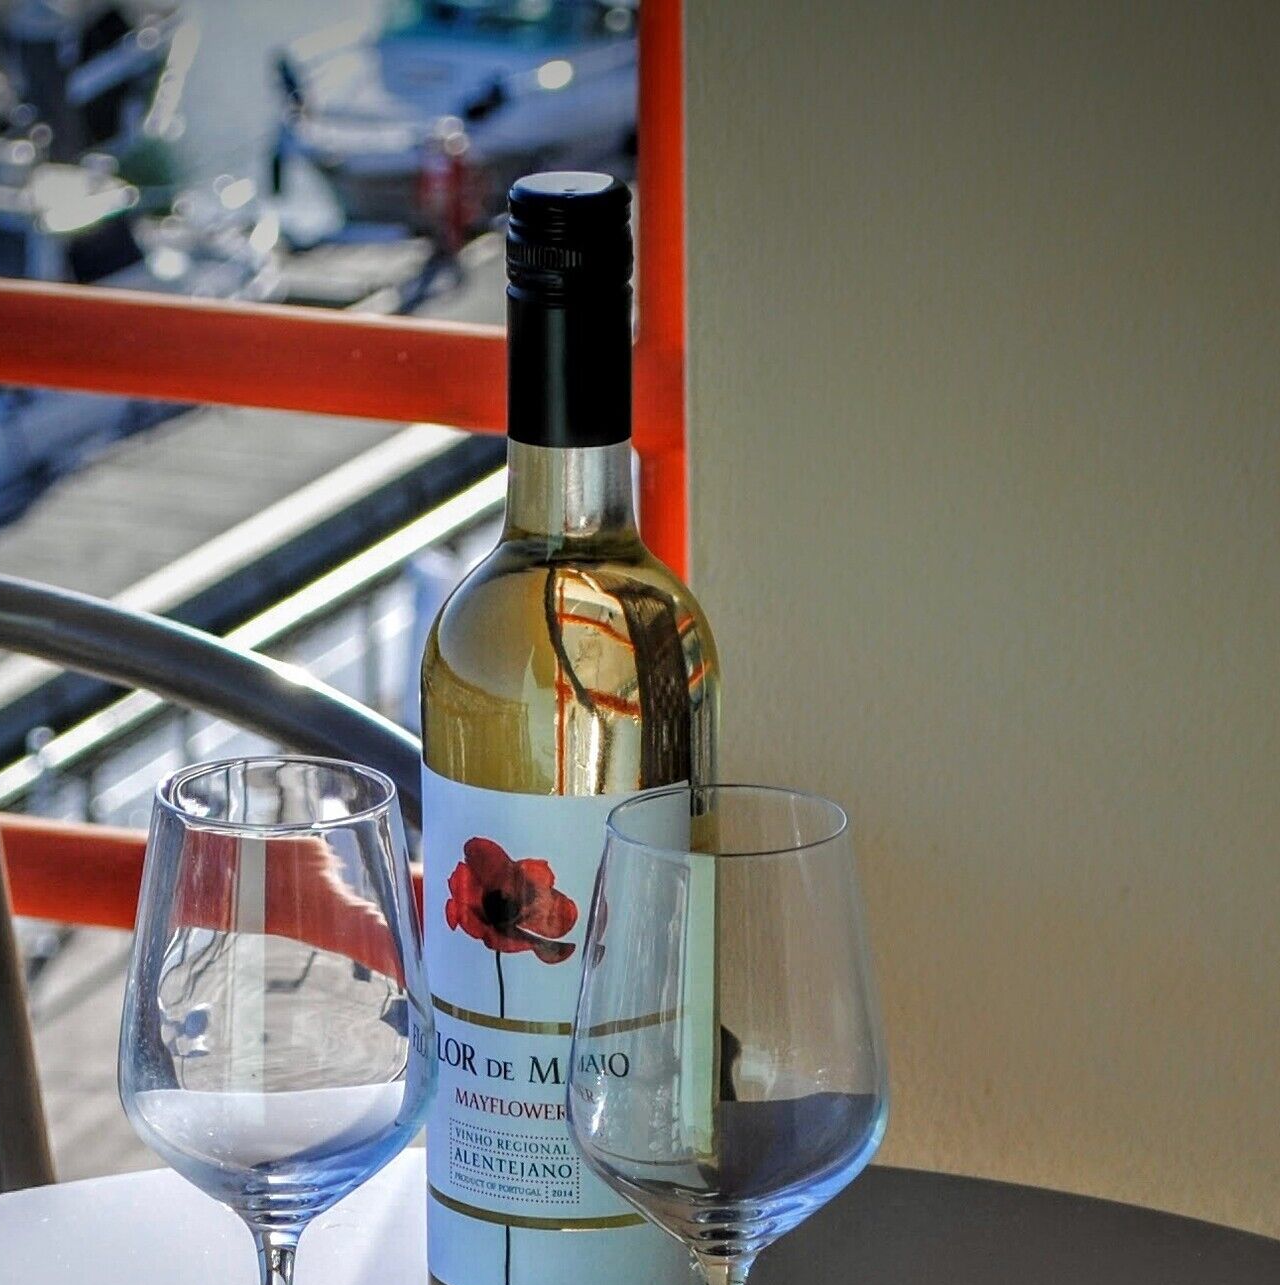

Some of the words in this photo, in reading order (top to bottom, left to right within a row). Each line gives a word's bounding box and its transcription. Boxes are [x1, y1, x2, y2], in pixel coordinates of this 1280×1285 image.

[486, 1057, 514, 1081] DE
[455, 1127, 493, 1147] VINHO
[497, 1138, 570, 1156] REGIONAL
[454, 1147, 572, 1179] ALENTEJANO
[498, 1184, 541, 1197] PORTUGAL
[551, 1188, 573, 1198] 2014
